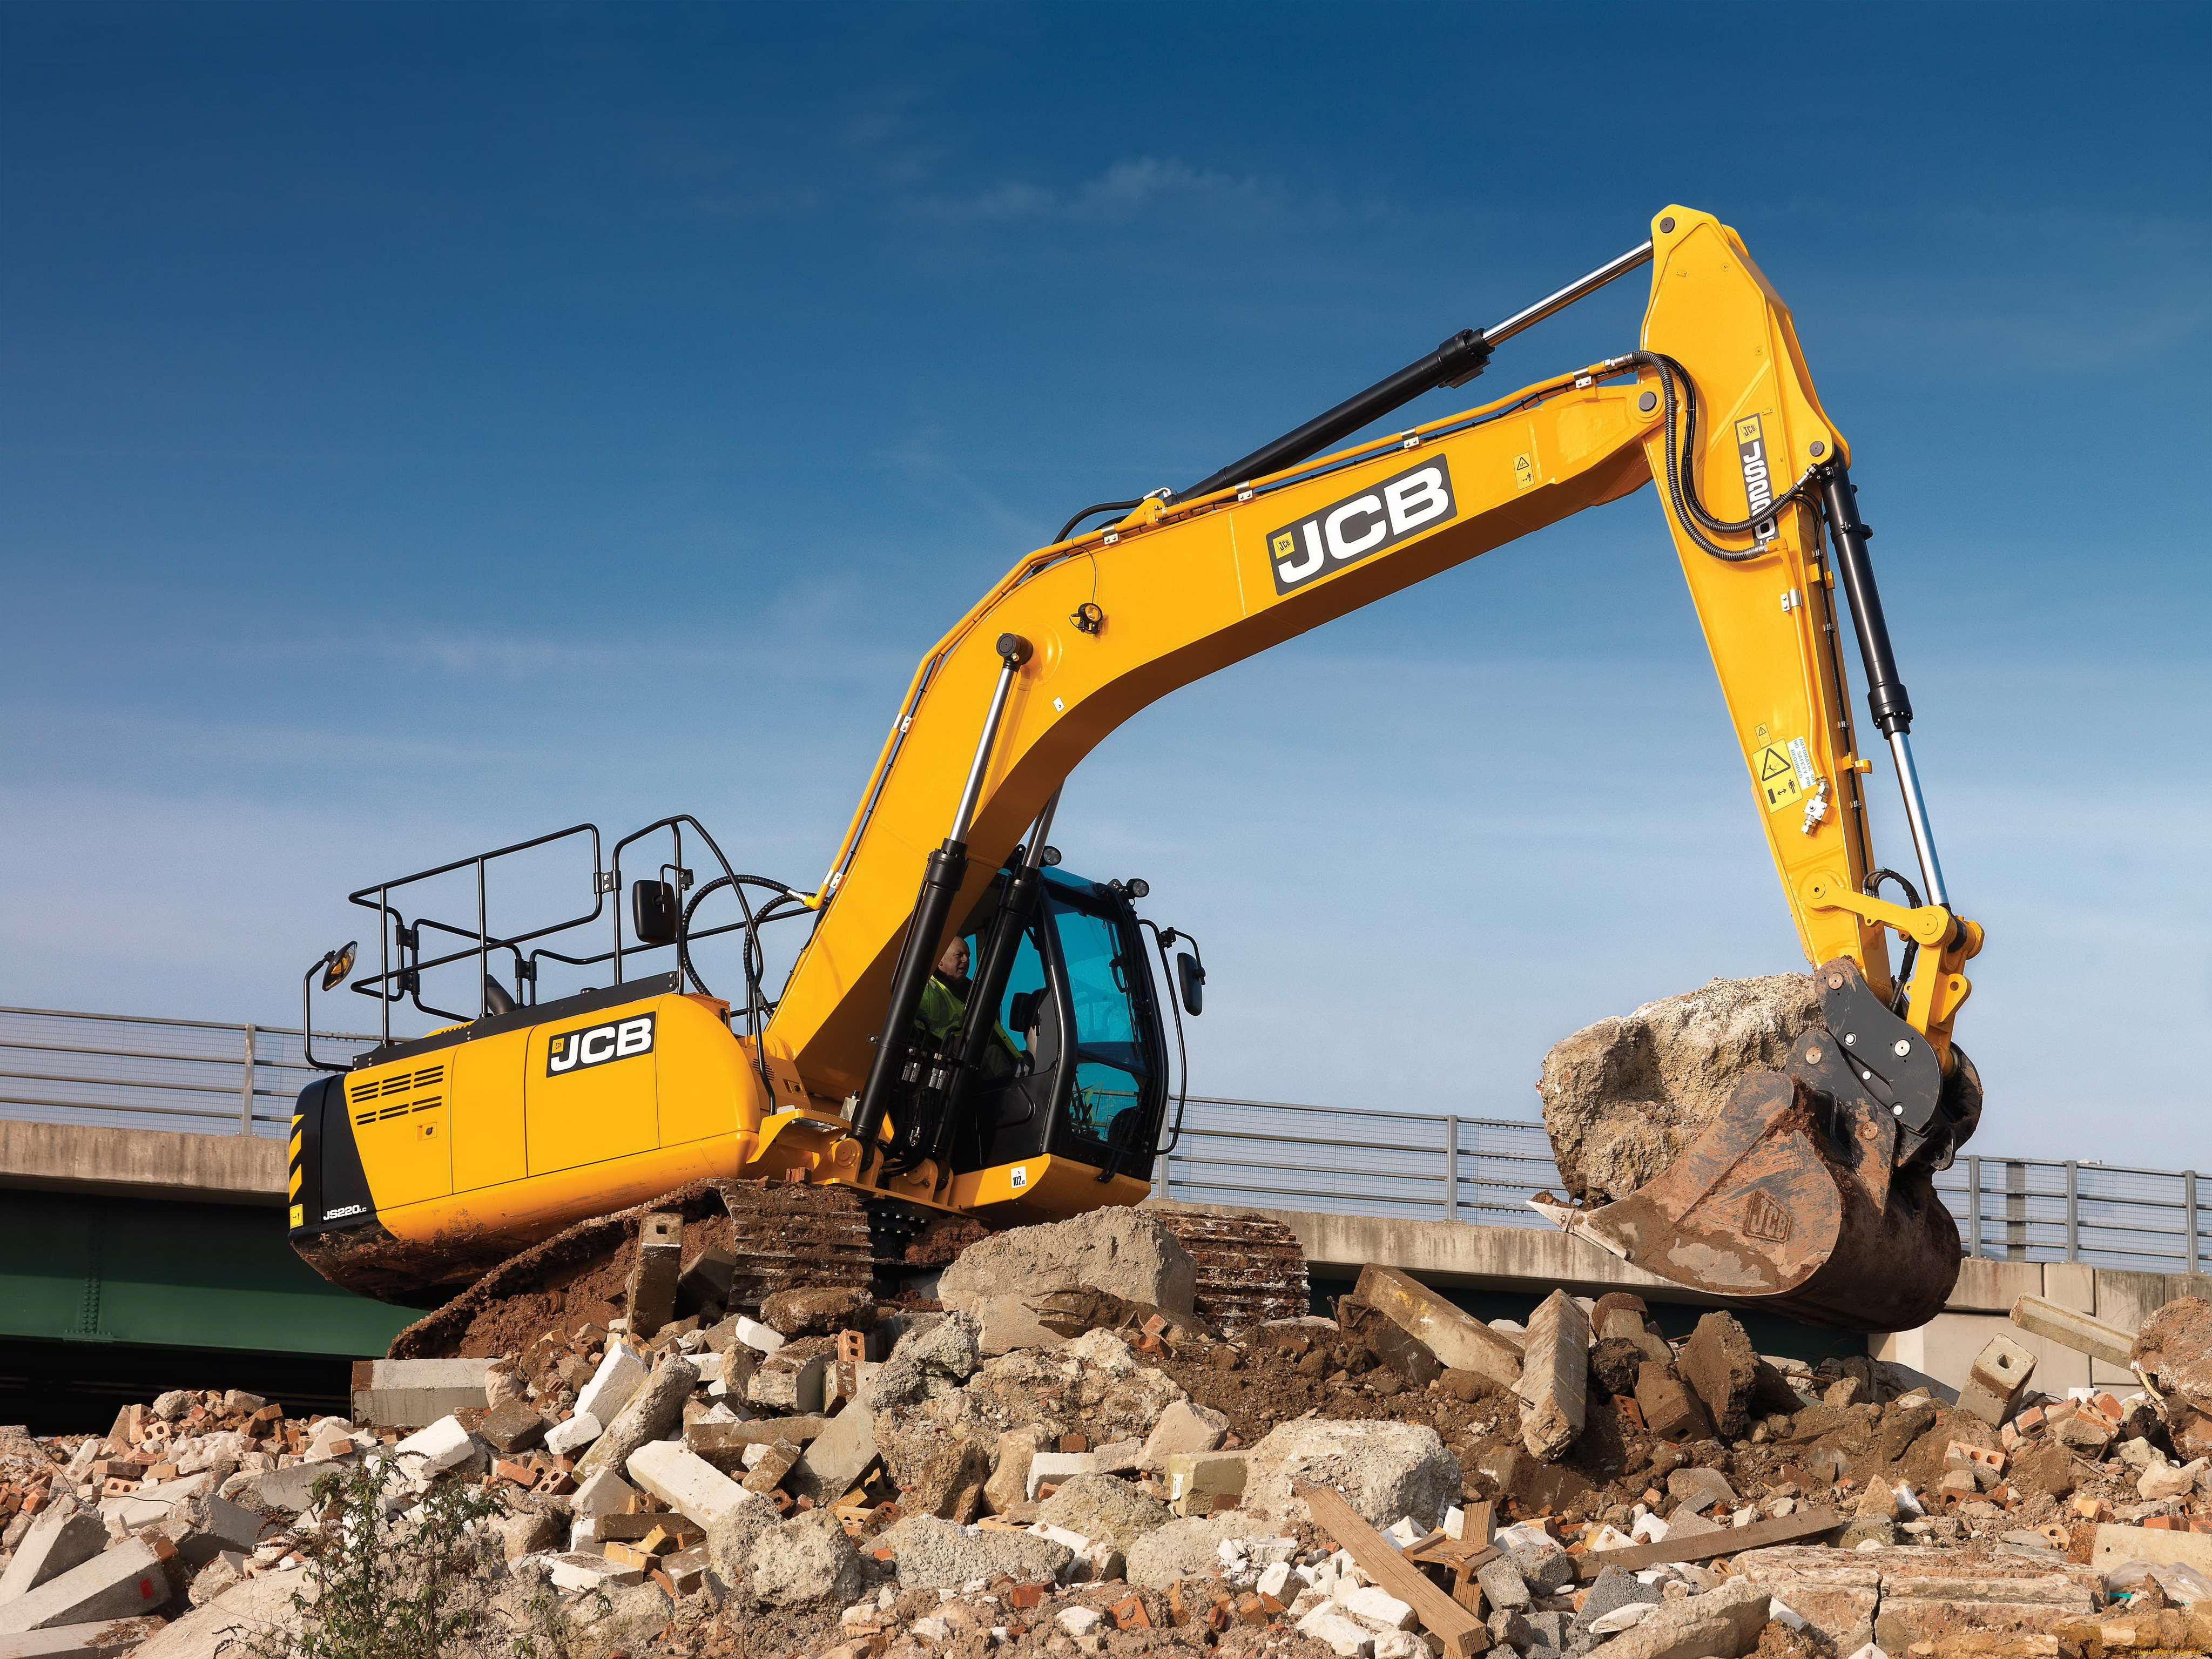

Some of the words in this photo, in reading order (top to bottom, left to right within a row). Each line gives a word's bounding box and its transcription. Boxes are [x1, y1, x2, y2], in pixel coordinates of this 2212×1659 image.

[1743, 425, 1756, 436] JCB
[1278, 467, 1449, 584] JCB
[1278, 540, 1290, 551] JCB
[1791, 749, 1803, 779] REQUIRED
[1793, 740, 1799, 748] NO
[1797, 751, 1808, 774] SAFETY
[1799, 738, 1812, 772] AUTOMATIC
[550, 1018, 652, 1071] JCB
[1013, 1176, 1022, 1186] 102
[1750, 1198, 1788, 1238] JCB
